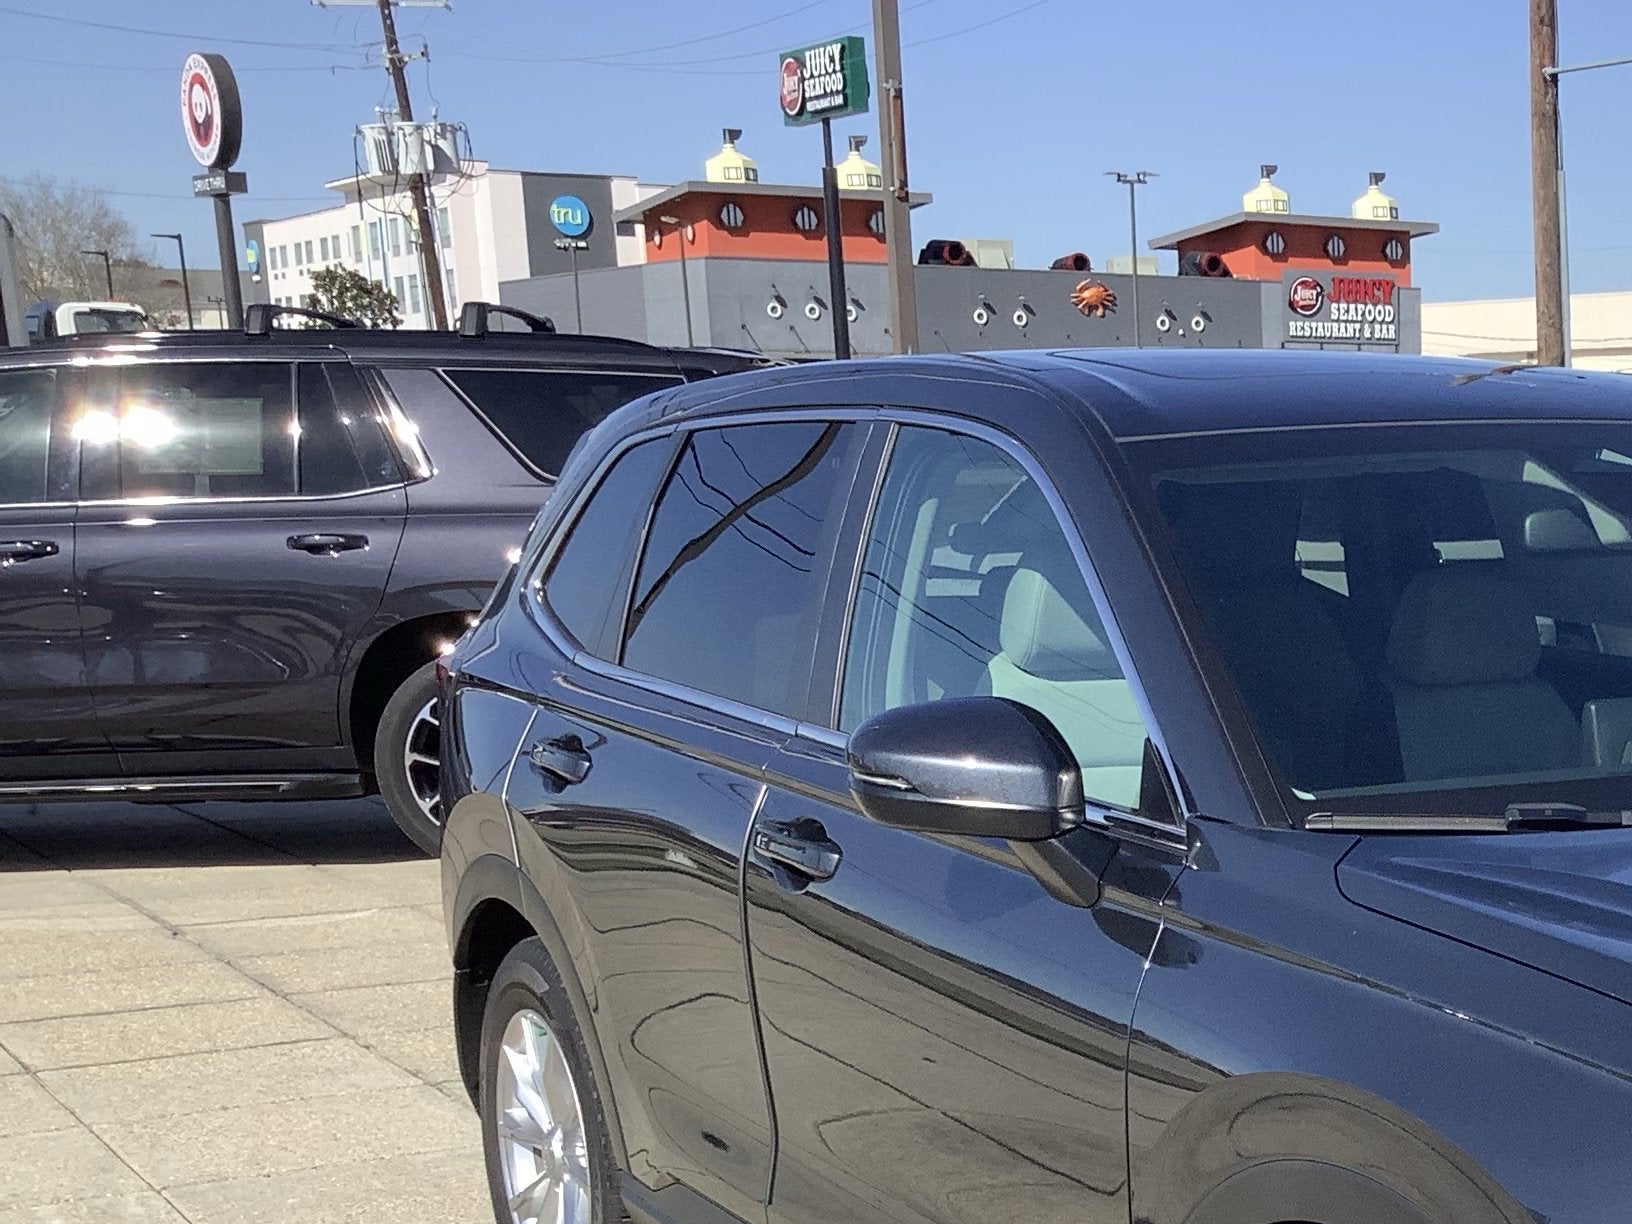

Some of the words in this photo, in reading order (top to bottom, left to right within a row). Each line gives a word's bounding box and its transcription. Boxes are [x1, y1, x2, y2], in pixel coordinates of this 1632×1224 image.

[803, 43, 842, 79] JUICY
[804, 72, 844, 98] SEAFOOD
[552, 202, 583, 225] tru
[1327, 277, 1395, 305] JUICY
[1330, 303, 1394, 322] SEAFOOD
[1289, 321, 1360, 338] RESTAURANT
[1363, 324, 1372, 338] &
[1374, 324, 1396, 339] BAR
